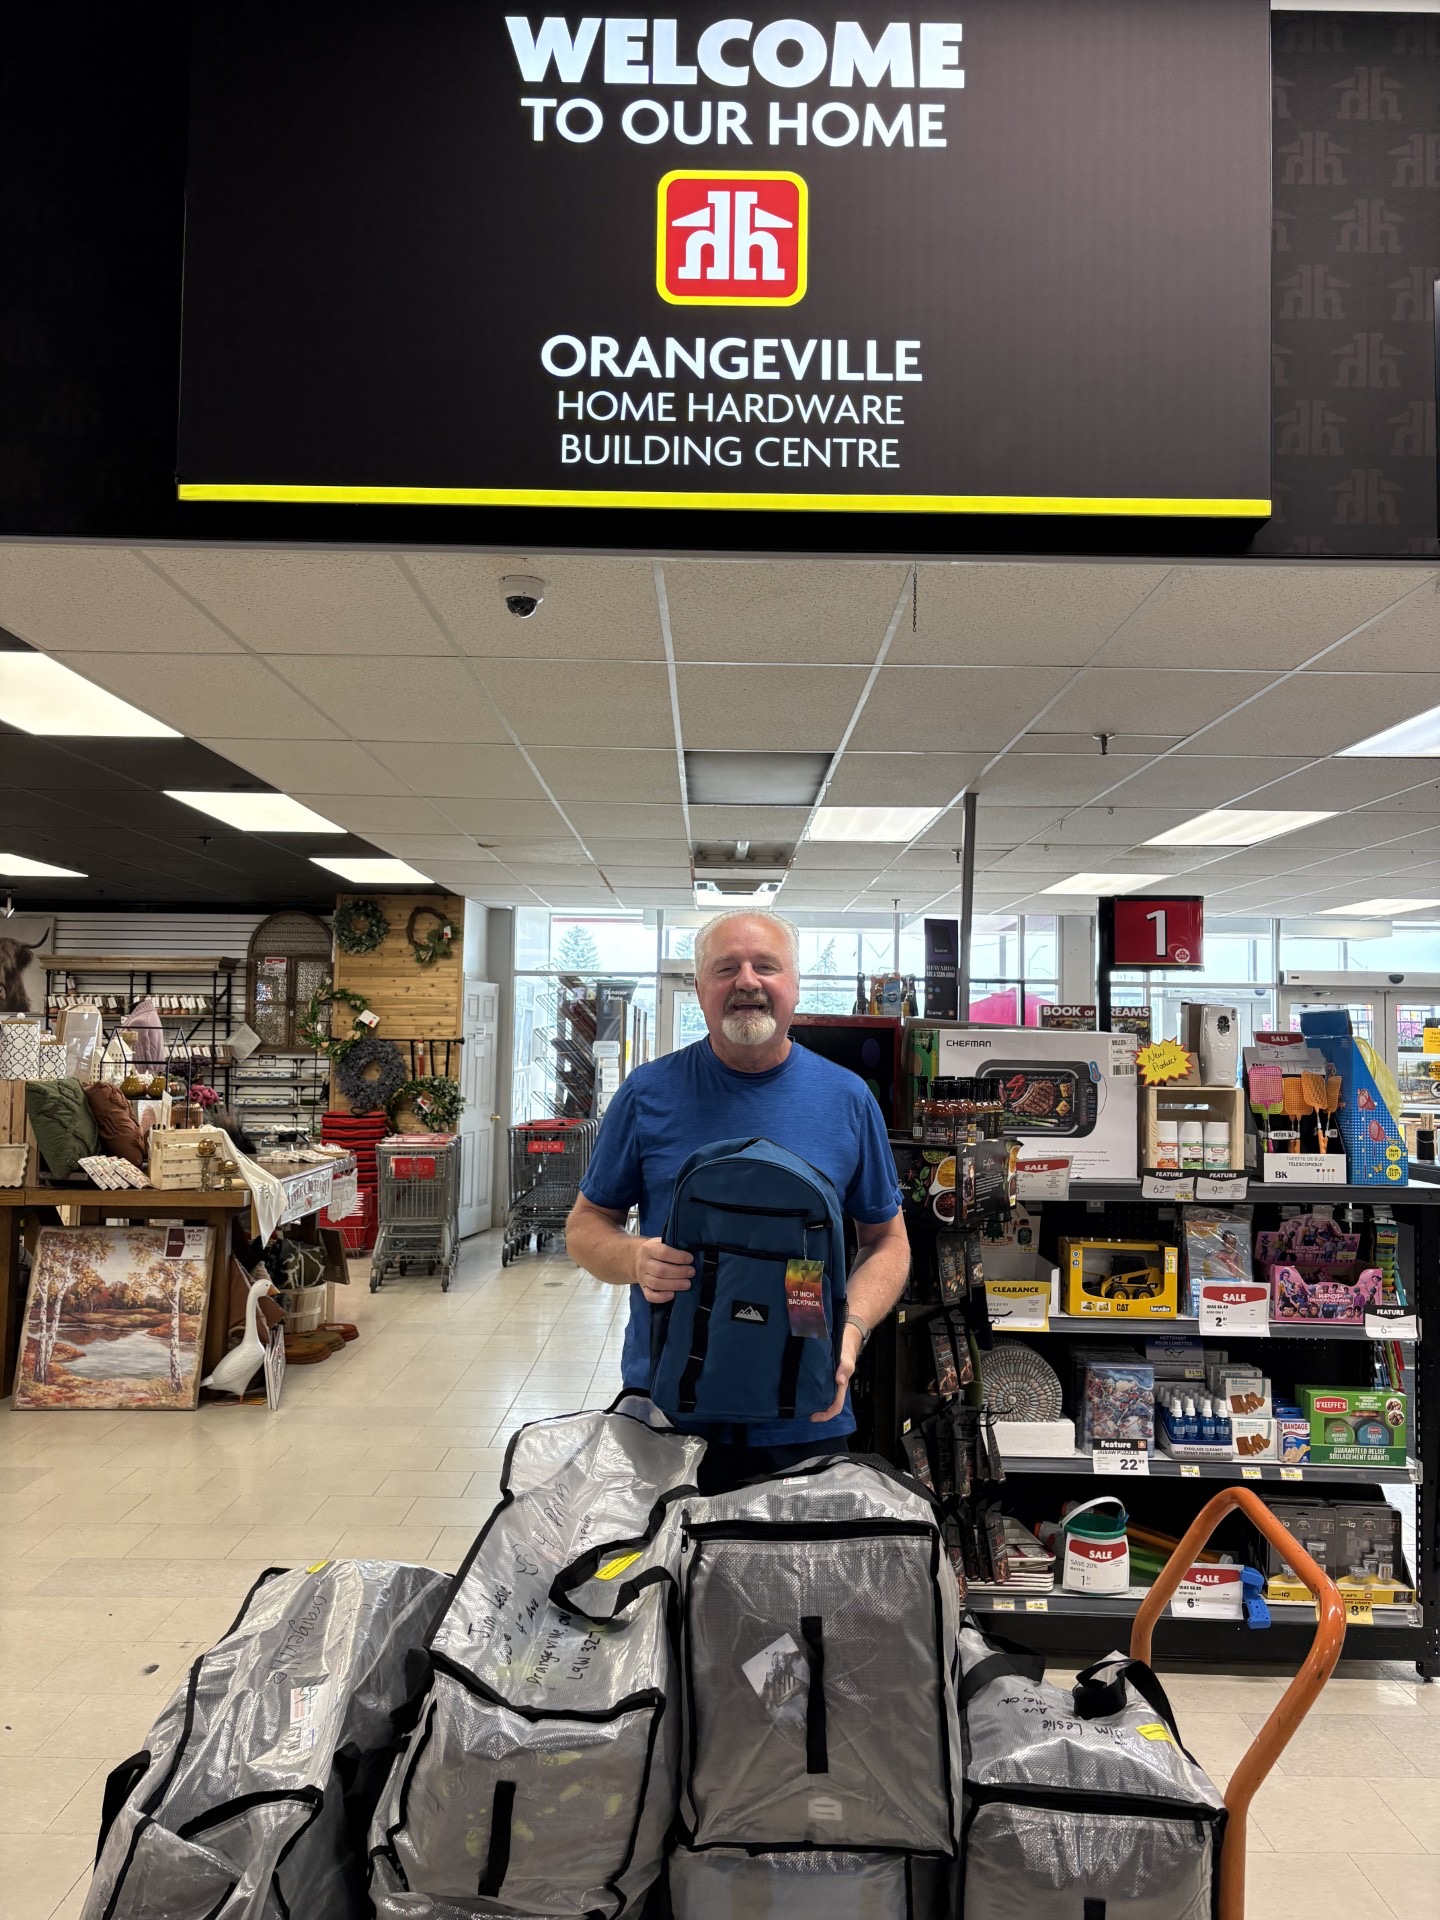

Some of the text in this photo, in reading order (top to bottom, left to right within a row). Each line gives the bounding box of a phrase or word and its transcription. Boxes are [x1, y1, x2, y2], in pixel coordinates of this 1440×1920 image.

[505, 16, 965, 88] WELCOME
[521, 98, 947, 147] TO OUR HOME
[541, 335, 922, 381] ORANGEVILLE
[558, 391, 905, 425] HOME HARDWARE
[561, 434, 900, 468] BUILDING CENTRE
[1146, 910, 1167, 956] 1
[1043, 1006, 1081, 1016] BOOK
[1111, 1007, 1149, 1017] REAMS
[946, 1040, 992, 1048] CHEFMAN
[1148, 1049, 1165, 1062] New
[1152, 1055, 1178, 1072] Product
[1275, 1171, 1288, 1179] BK
[788, 1298, 821, 1307] BACKPACK
[1222, 1293, 1247, 1302] SALE
[1116, 1303, 1130, 1312] CAT
[1215, 1317, 1223, 1327] 2
[1316, 1401, 1347, 1409] O'KEEFFE'S
[1100, 1440, 1132, 1449] Feature
[1119, 1458, 1138, 1471] 22
[1088, 1550, 1113, 1560] SALE
[1070, 1559, 1086, 1568] SAVE
[1195, 1574, 1220, 1583] SALE
[1187, 1598, 1195, 1608] 6
[1351, 1605, 1359, 1616] 8
[1042, 1719, 1083, 1736] Leslie
[1095, 1725, 1124, 1746] Jim
